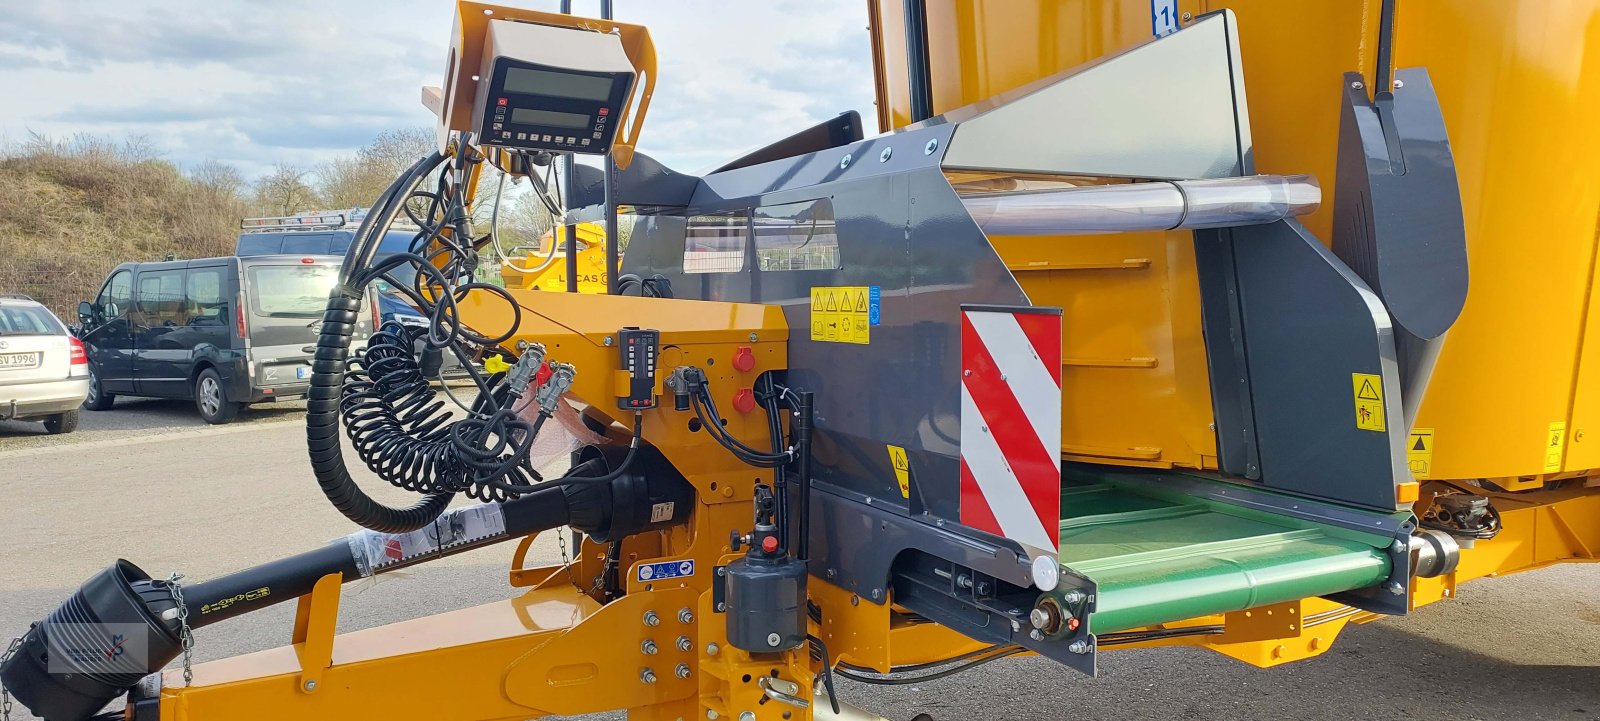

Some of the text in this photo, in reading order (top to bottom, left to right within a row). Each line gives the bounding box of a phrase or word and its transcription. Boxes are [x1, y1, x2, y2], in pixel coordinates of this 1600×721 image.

[1161, 6, 1169, 26] 1
[559, 274, 598, 283] LCAS
[11, 354, 34, 364] 1996
